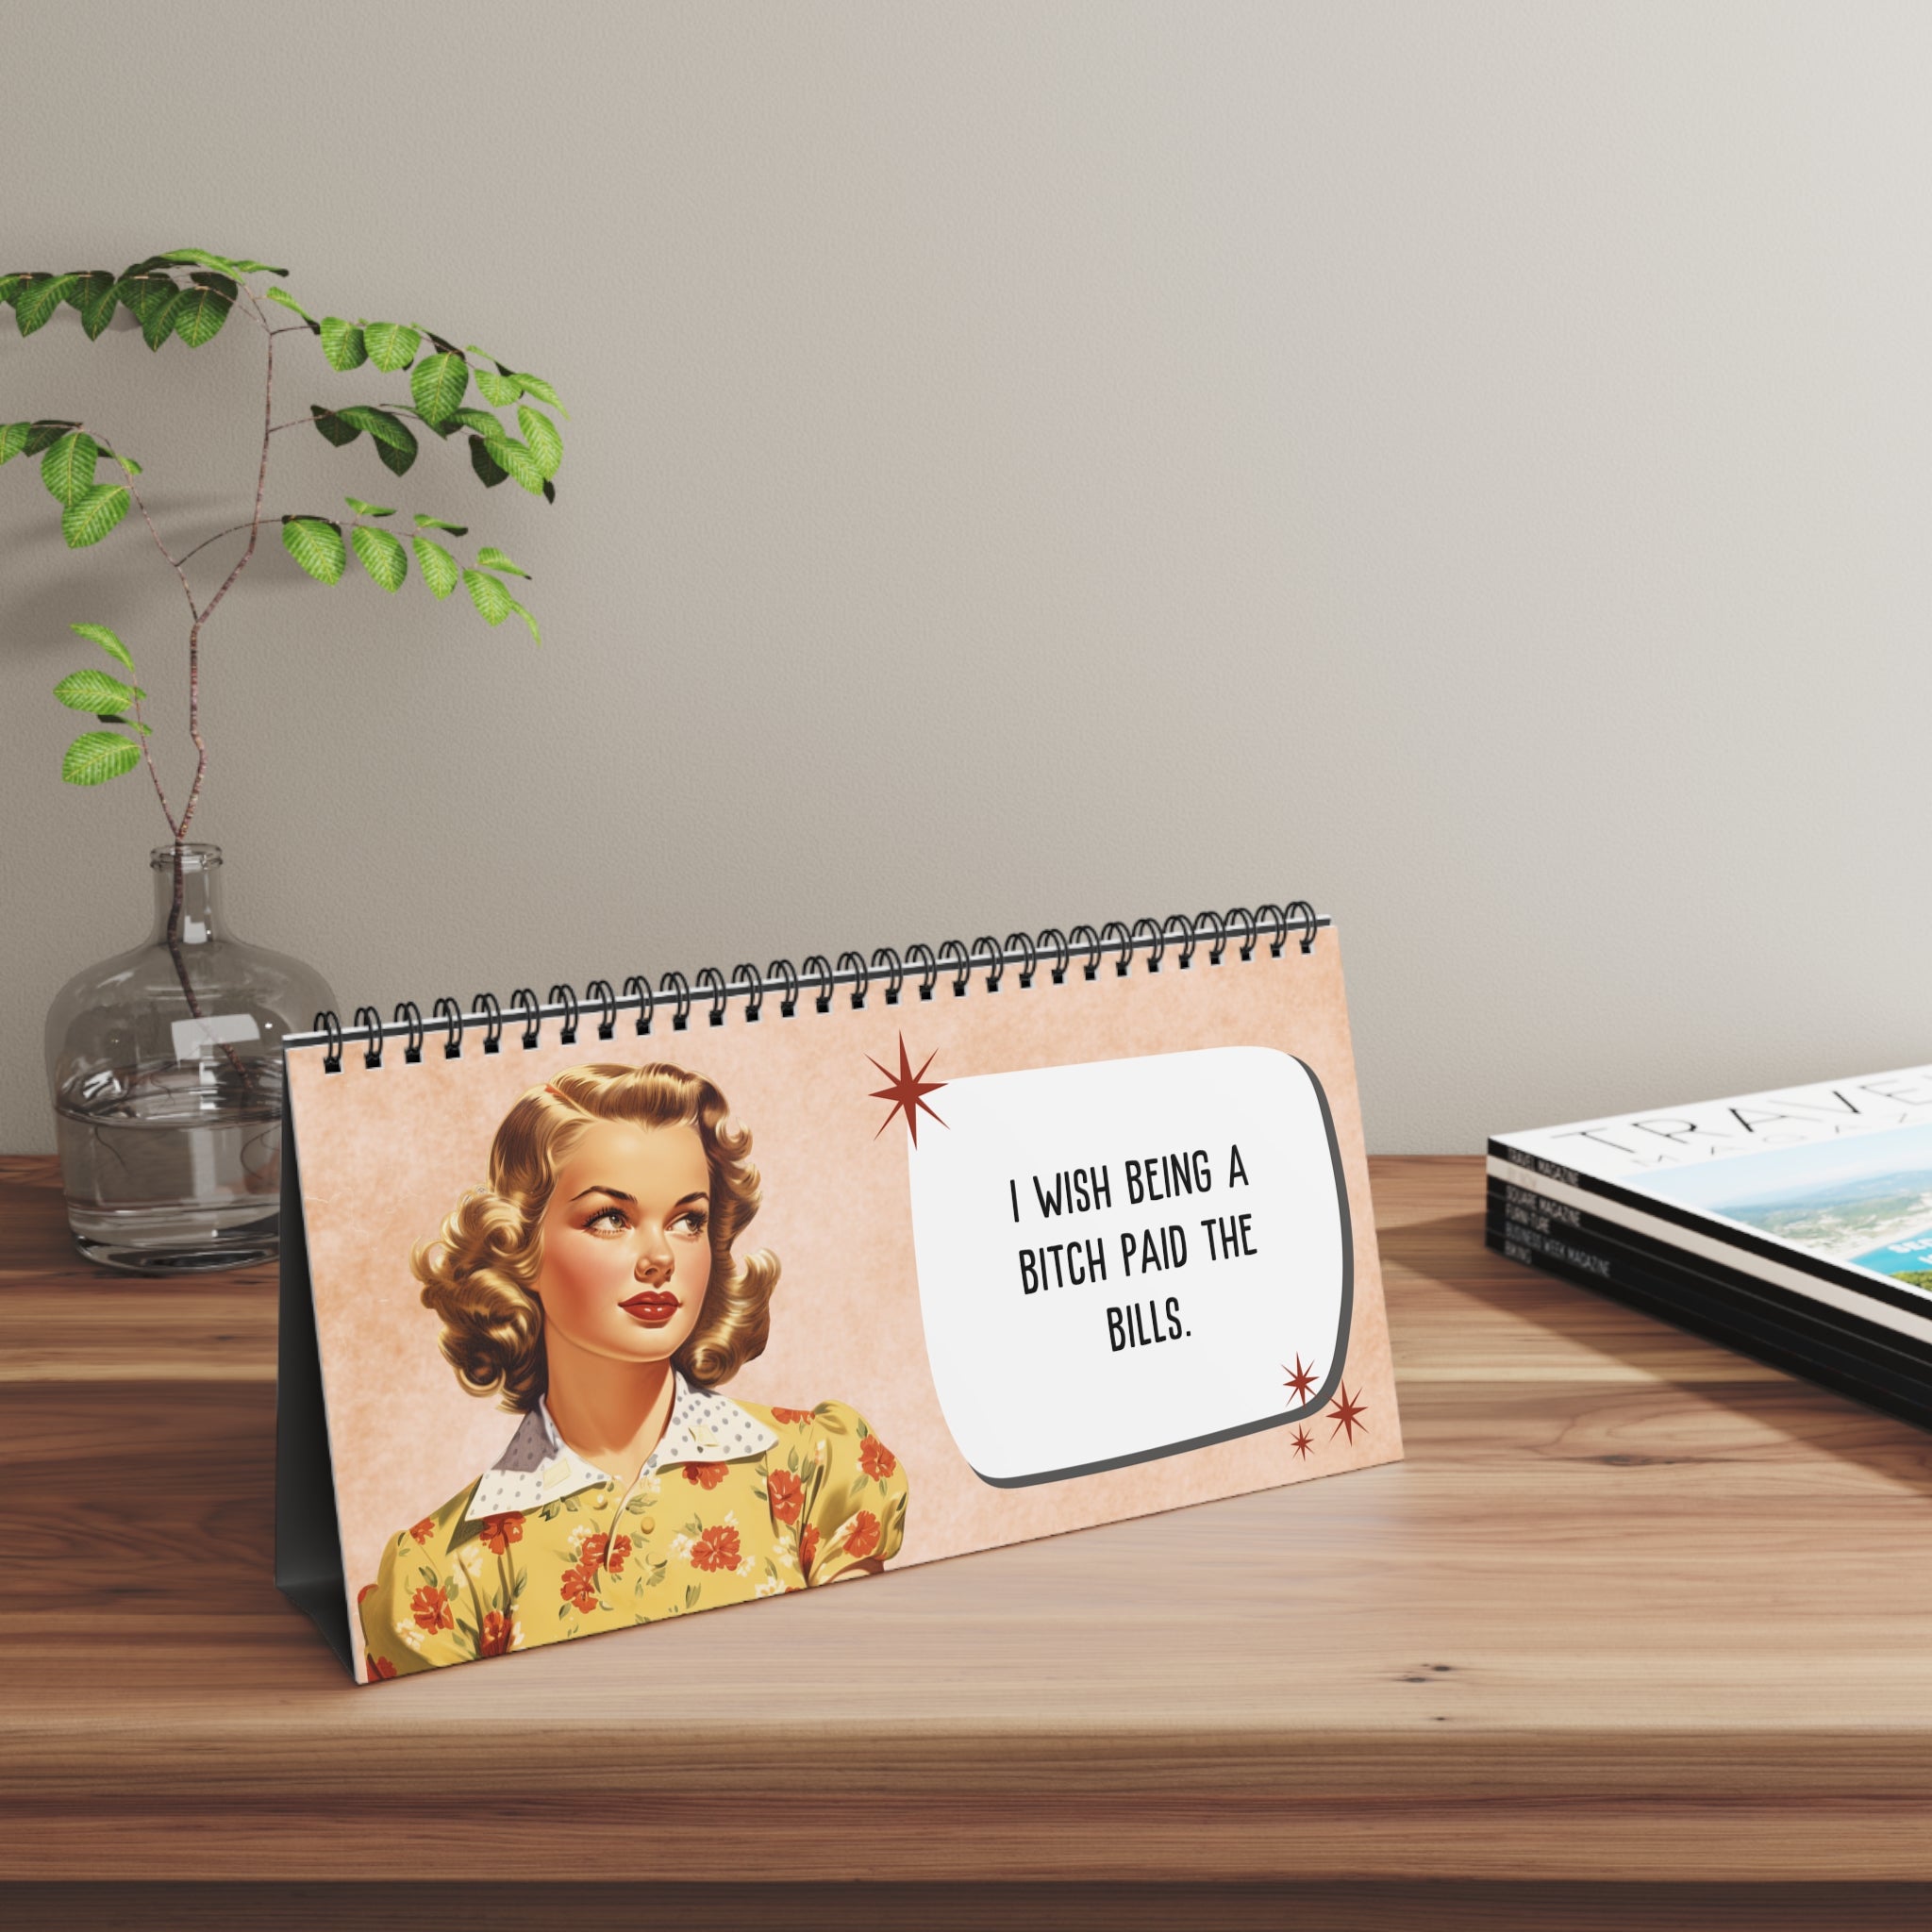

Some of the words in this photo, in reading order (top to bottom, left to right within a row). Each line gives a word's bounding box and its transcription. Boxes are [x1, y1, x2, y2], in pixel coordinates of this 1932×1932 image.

[1550, 1074, 1932, 1154] TRAVE
[1009, 1179, 1020, 1223] I
[1032, 1165, 1112, 1218] WISH
[1124, 1149, 1212, 1205] BEING
[1229, 1144, 1249, 1189] A
[1538, 1159, 1579, 1188] MAGAZINE
[1539, 1197, 1580, 1226] MAGAZINE
[1018, 1237, 1108, 1295] BITCH
[1120, 1224, 1188, 1276] PAID
[1200, 1213, 1257, 1261] THE
[1567, 1246, 1610, 1277] MAGAZINE
[1106, 1296, 1192, 1352] BILLS.
